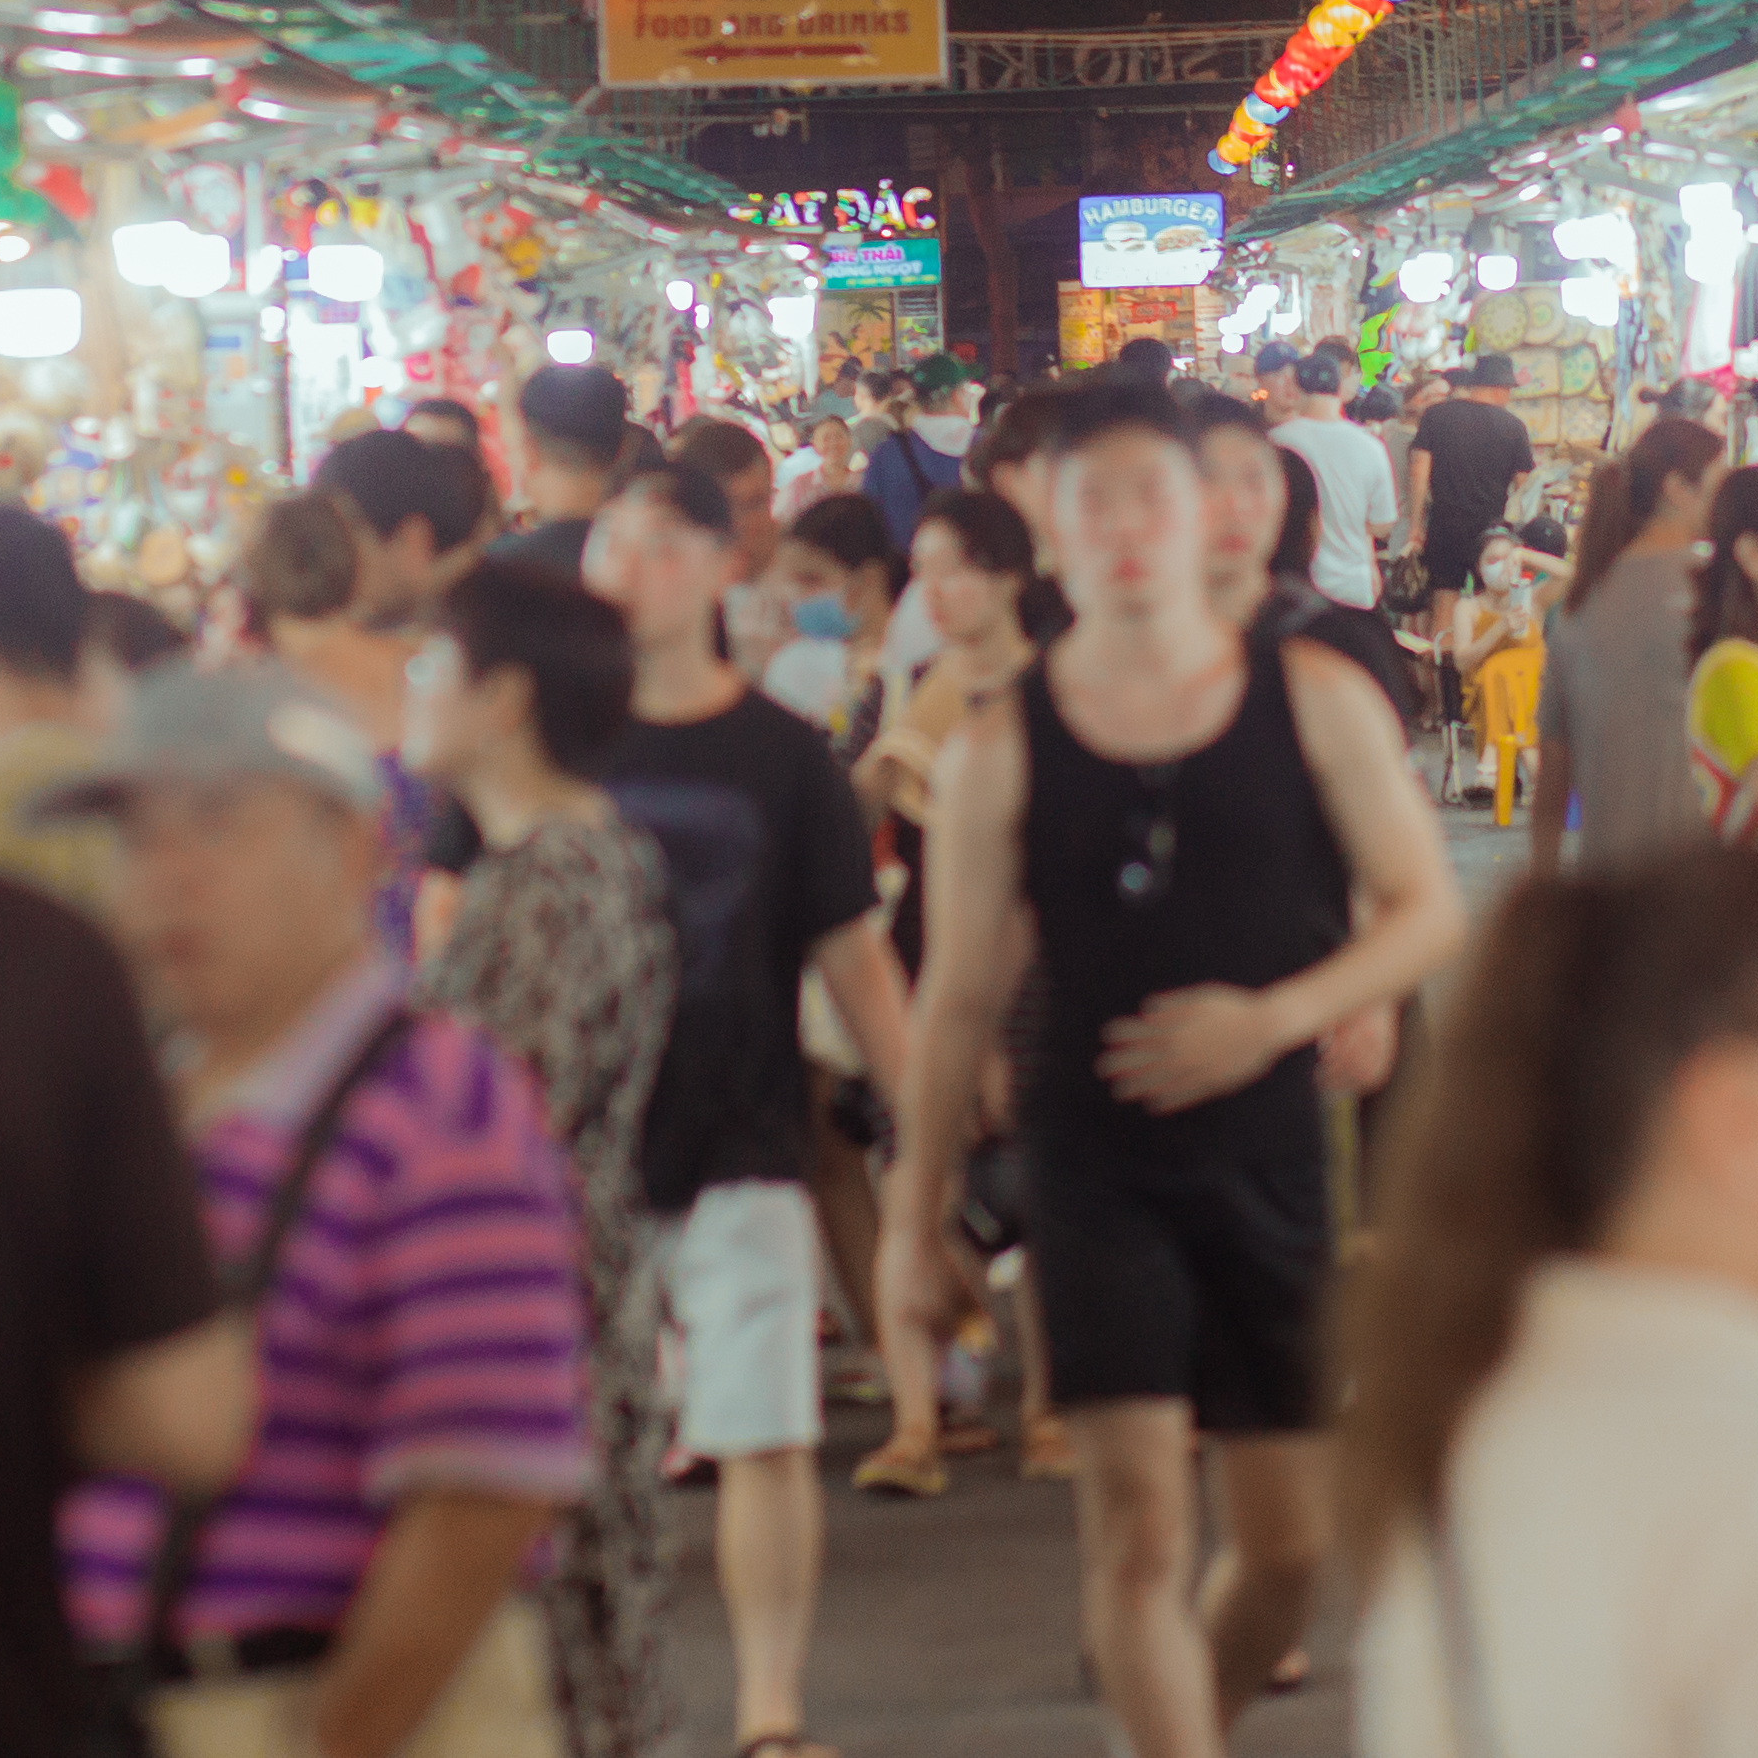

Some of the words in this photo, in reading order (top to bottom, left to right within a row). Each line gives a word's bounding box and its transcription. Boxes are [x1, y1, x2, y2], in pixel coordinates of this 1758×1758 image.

[634, 14, 712, 39] FOOD
[796, 9, 910, 36] DRINKS
[1083, 197, 1220, 228] HAMBURGER
